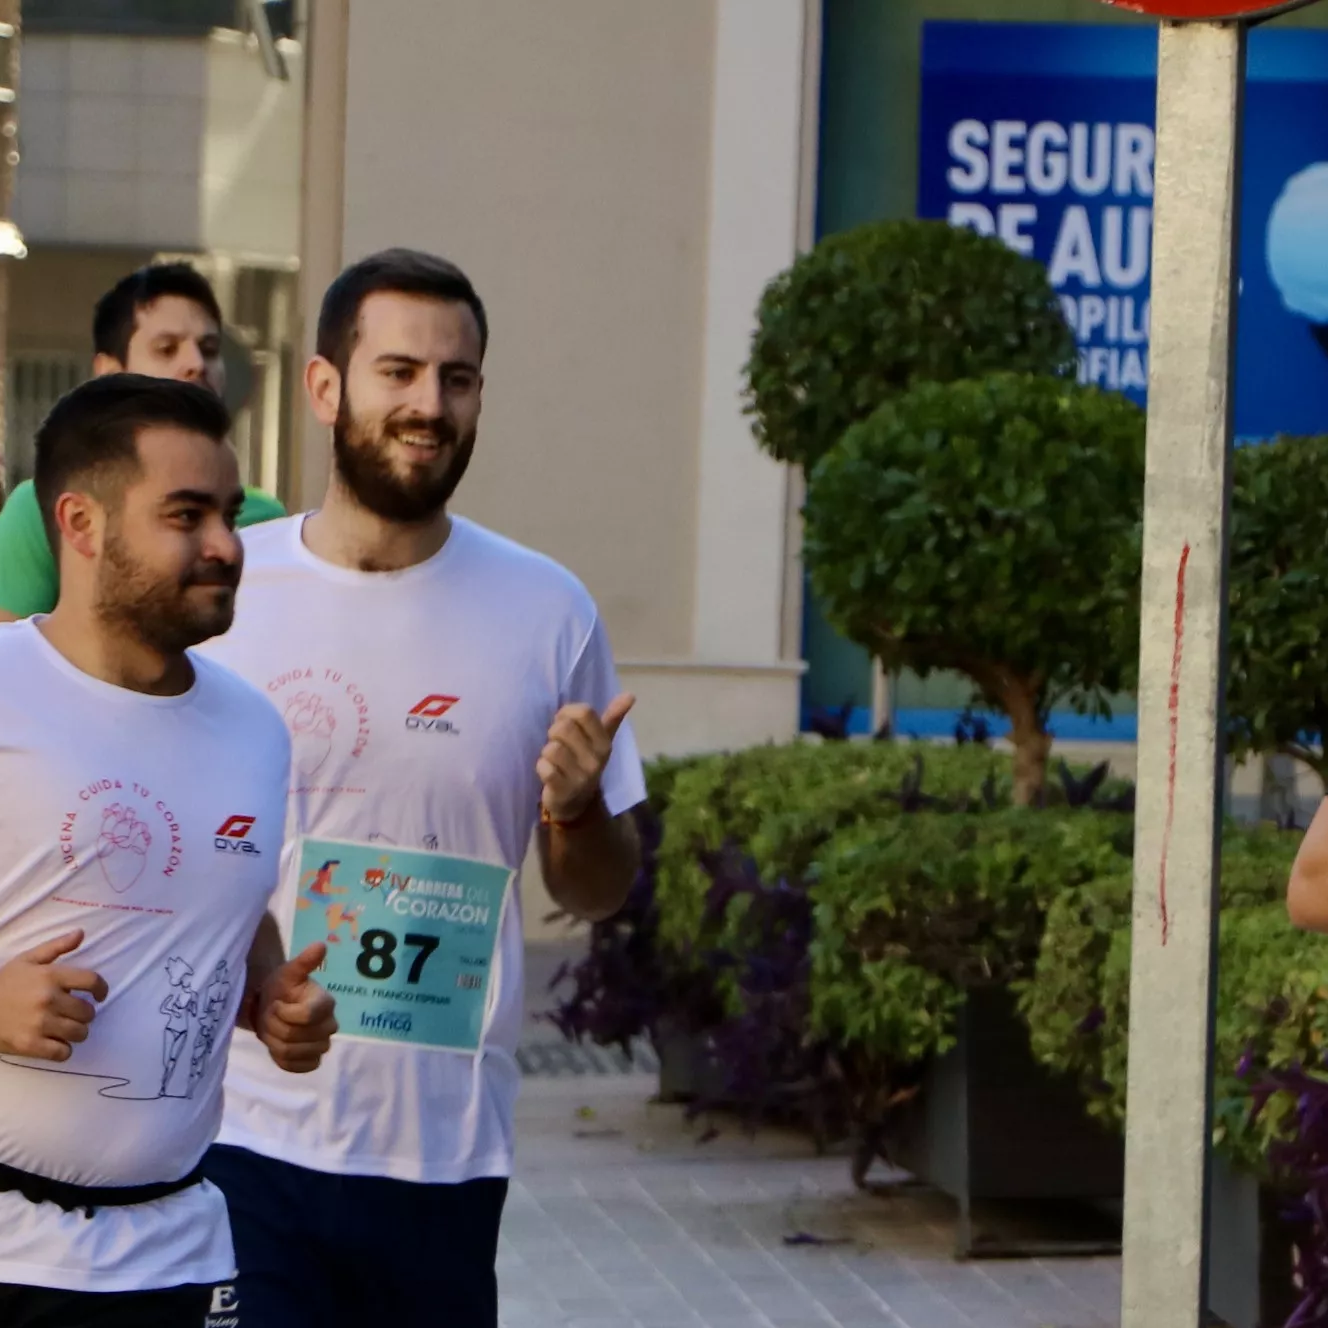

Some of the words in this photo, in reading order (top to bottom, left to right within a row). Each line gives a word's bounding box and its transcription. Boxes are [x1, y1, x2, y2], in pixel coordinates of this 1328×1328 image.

[267, 666, 313, 692] CUIDA
[323, 668, 344, 683] TU
[78, 778, 123, 802] CUIDA
[132, 782, 150, 799] TU
[354, 928, 441, 986] 87
